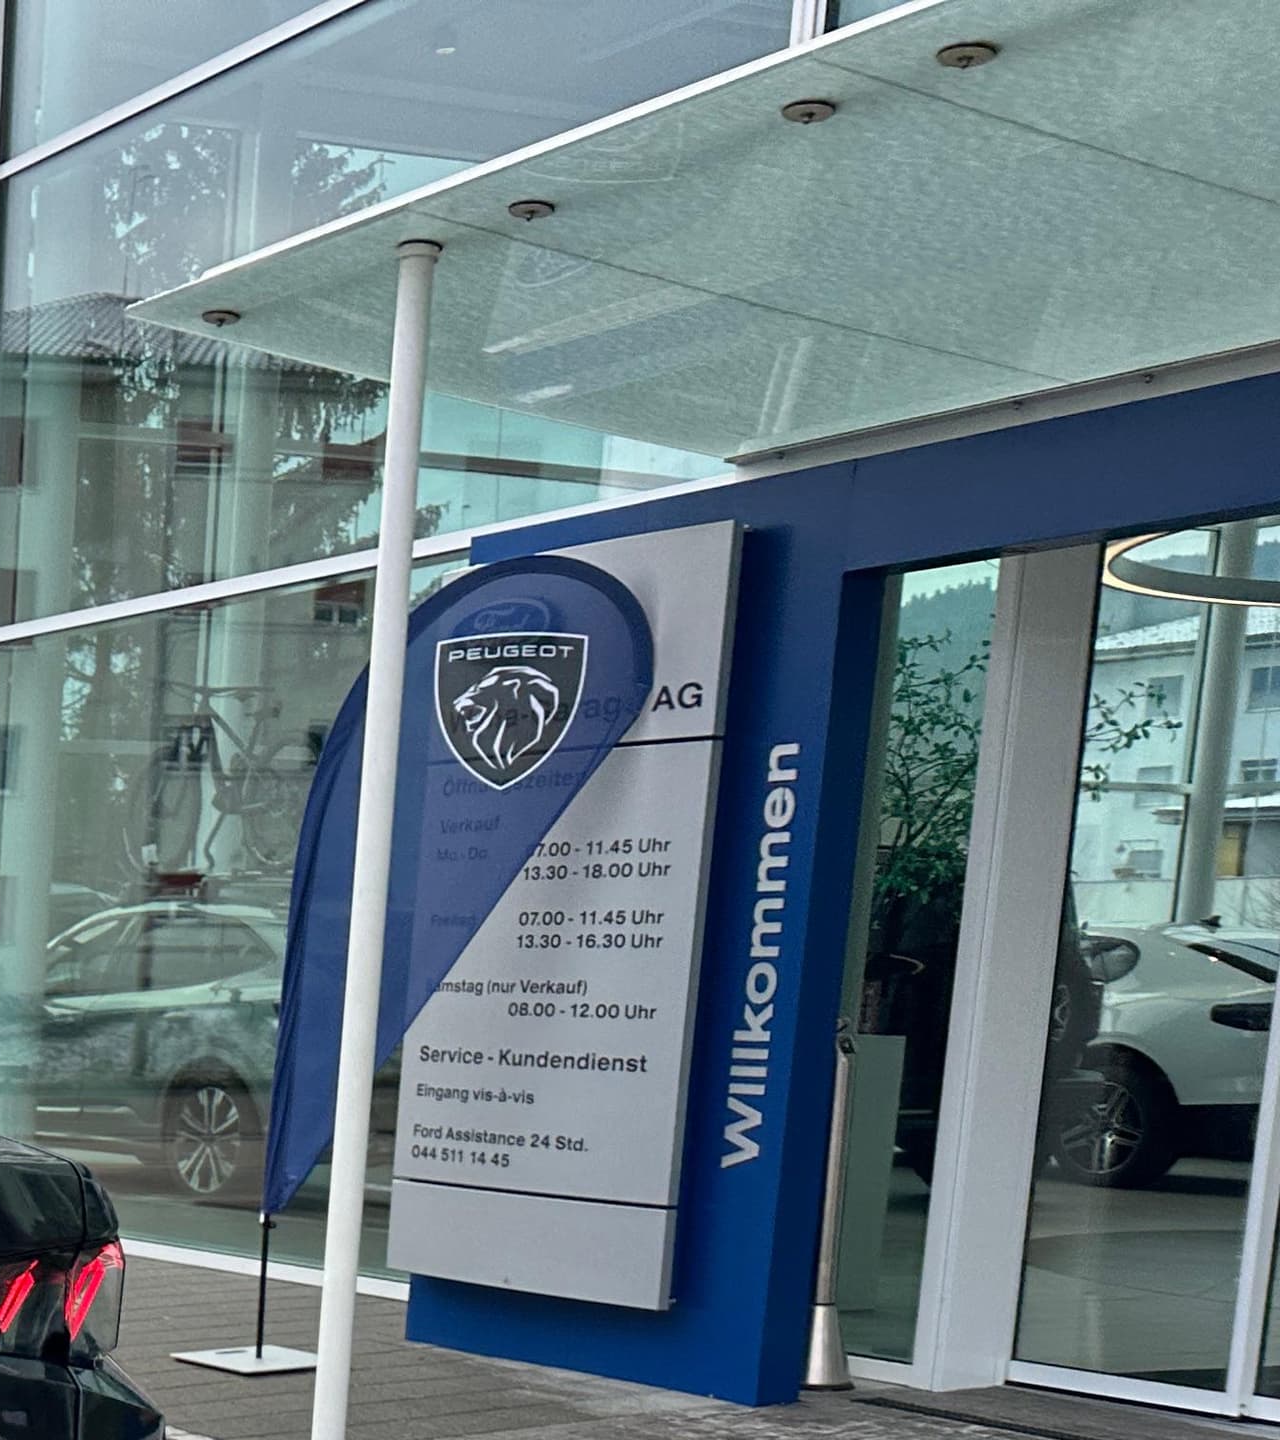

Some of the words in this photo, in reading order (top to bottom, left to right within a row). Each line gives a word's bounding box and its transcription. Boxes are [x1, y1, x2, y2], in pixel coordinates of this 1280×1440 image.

[448, 645, 574, 662] PEUGEOT
[651, 682, 704, 713] AG
[528, 842, 571, 857] 7.00
[587, 839, 632, 855] 11.45
[639, 838, 671, 853] Uhr
[523, 865, 568, 880] 13.30
[583, 863, 633, 879] 18.00
[639, 862, 671, 877] Uhr
[519, 911, 565, 926] 07.00
[579, 910, 626, 926] 11.45
[632, 910, 664, 925] Uhr
[516, 934, 561, 949] 13.30
[577, 933, 626, 949] 16.30
[631, 933, 663, 948] Uhr
[720, 741, 801, 1168] Willkommen
[487, 980, 515, 995] (nur
[520, 979, 588, 997] Verkauf)
[508, 1002, 556, 1018] 08.00
[571, 1003, 620, 1019] 12.00
[625, 1004, 657, 1020] Uhr
[419, 1045, 484, 1065] Service
[498, 1049, 648, 1073] Kundendienst
[416, 1083, 469, 1103] Eingang
[473, 1087, 535, 1105] vis-à-vis
[413, 1124, 442, 1140] Ford
[445, 1127, 526, 1147] Assistance
[530, 1134, 551, 1150] 24
[555, 1135, 589, 1152] Std.
[411, 1145, 437, 1160] 044
[441, 1147, 464, 1163] 511
[470, 1150, 486, 1165] 14
[490, 1152, 510, 1168] 45
